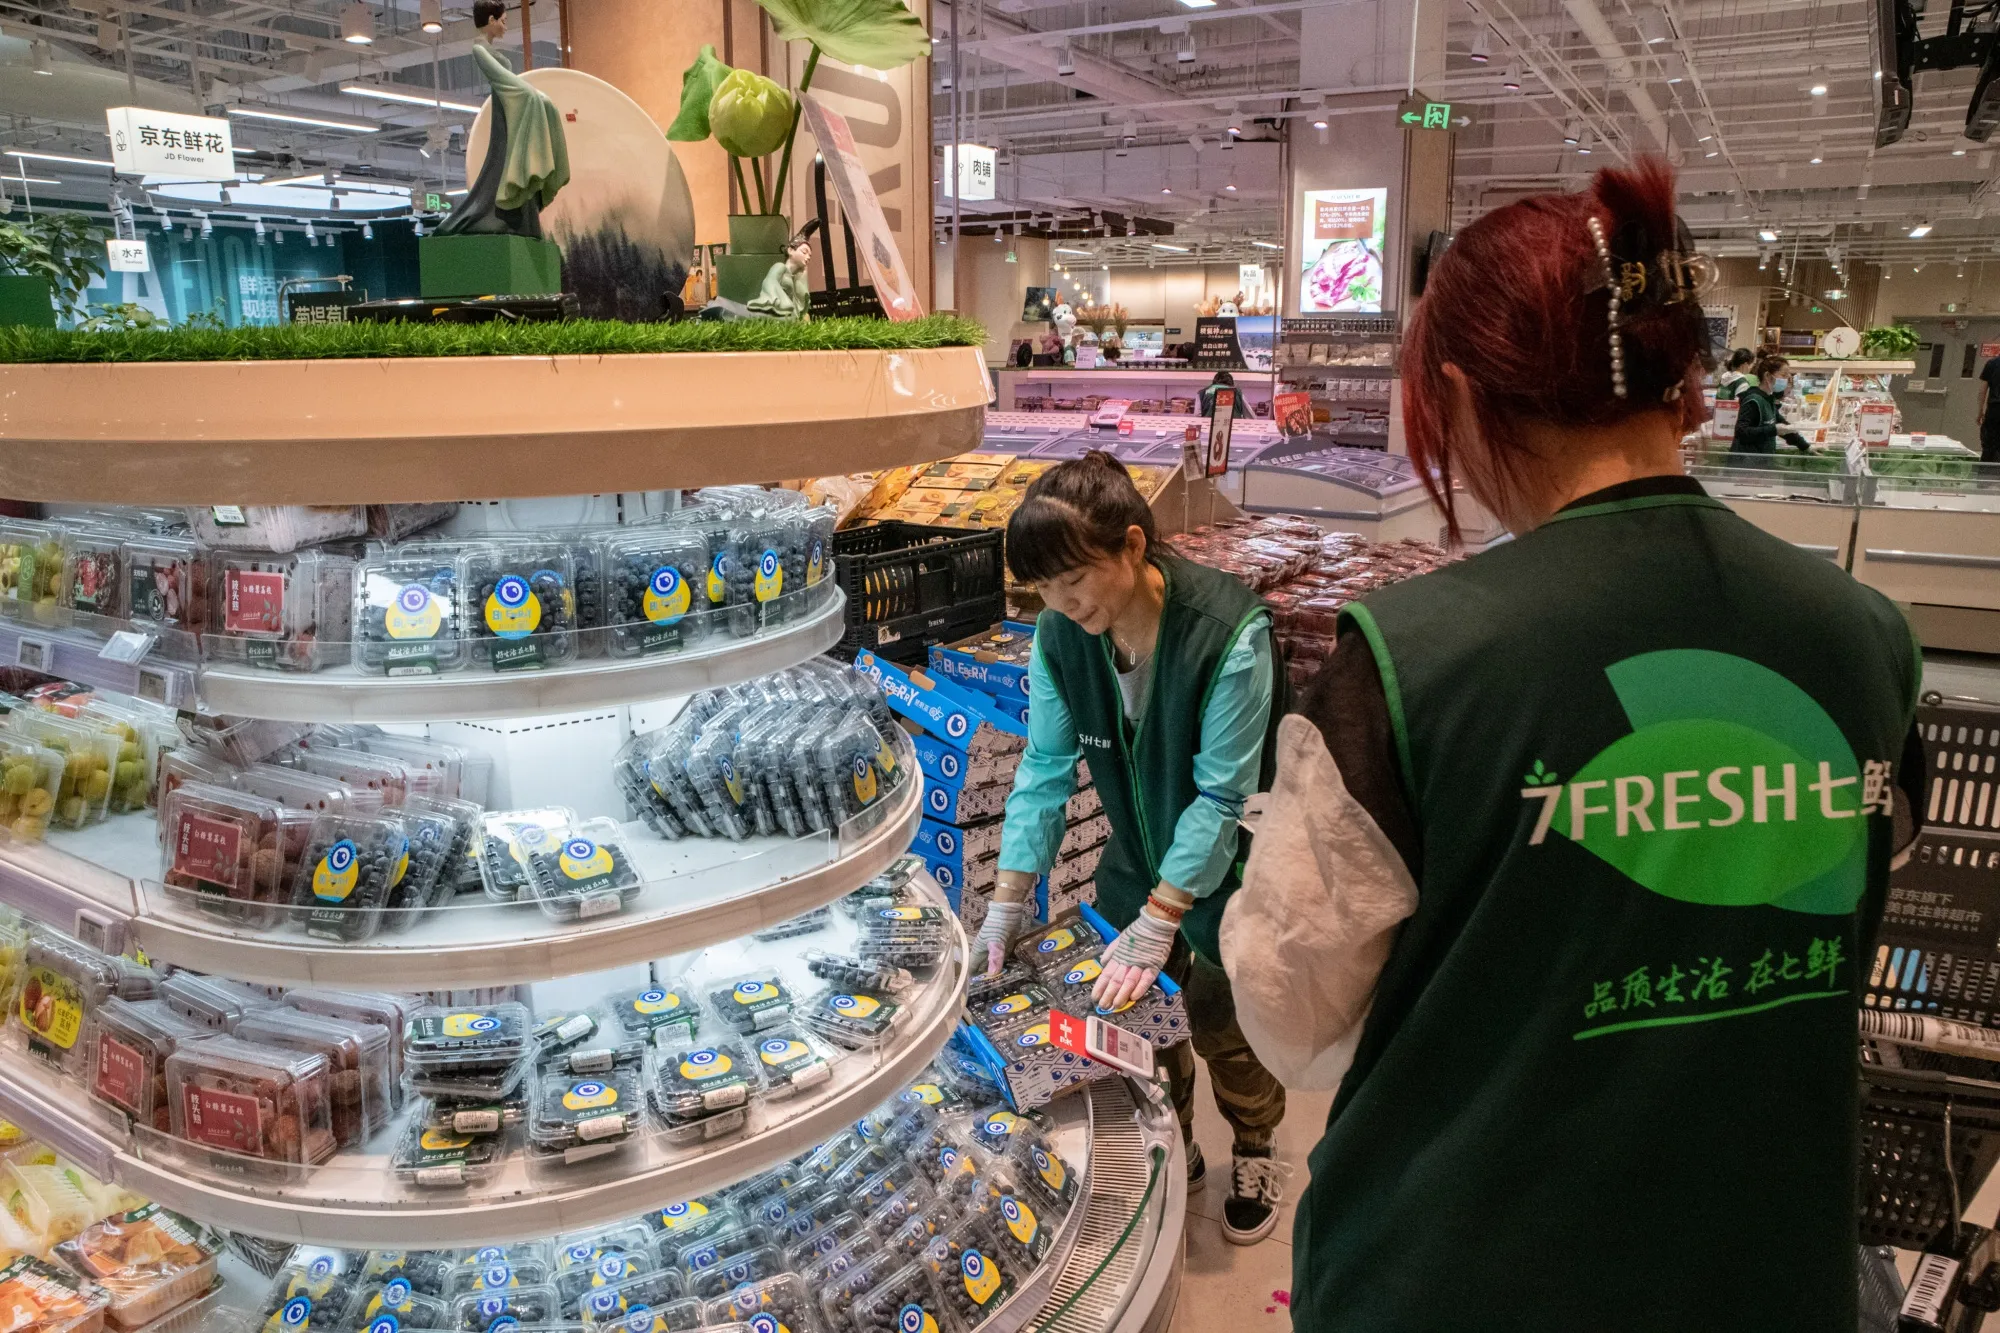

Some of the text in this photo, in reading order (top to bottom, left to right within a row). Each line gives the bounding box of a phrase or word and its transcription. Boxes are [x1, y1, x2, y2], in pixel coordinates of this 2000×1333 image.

[138, 125, 224, 153] 京东鲜花
[164, 152, 205, 163] JD Flower
[973, 159, 992, 178] 肉铺
[121, 248, 143, 258] 水产
[1079, 733, 1111, 748] SH七鲜
[1888, 888, 1954, 905] 京东旗下
[1884, 901, 1984, 922] 美食生鲜超市
[1882, 915, 1979, 932] SEVEN FRESH
[1584, 936, 1847, 1020] 品质生活 在七鲜
